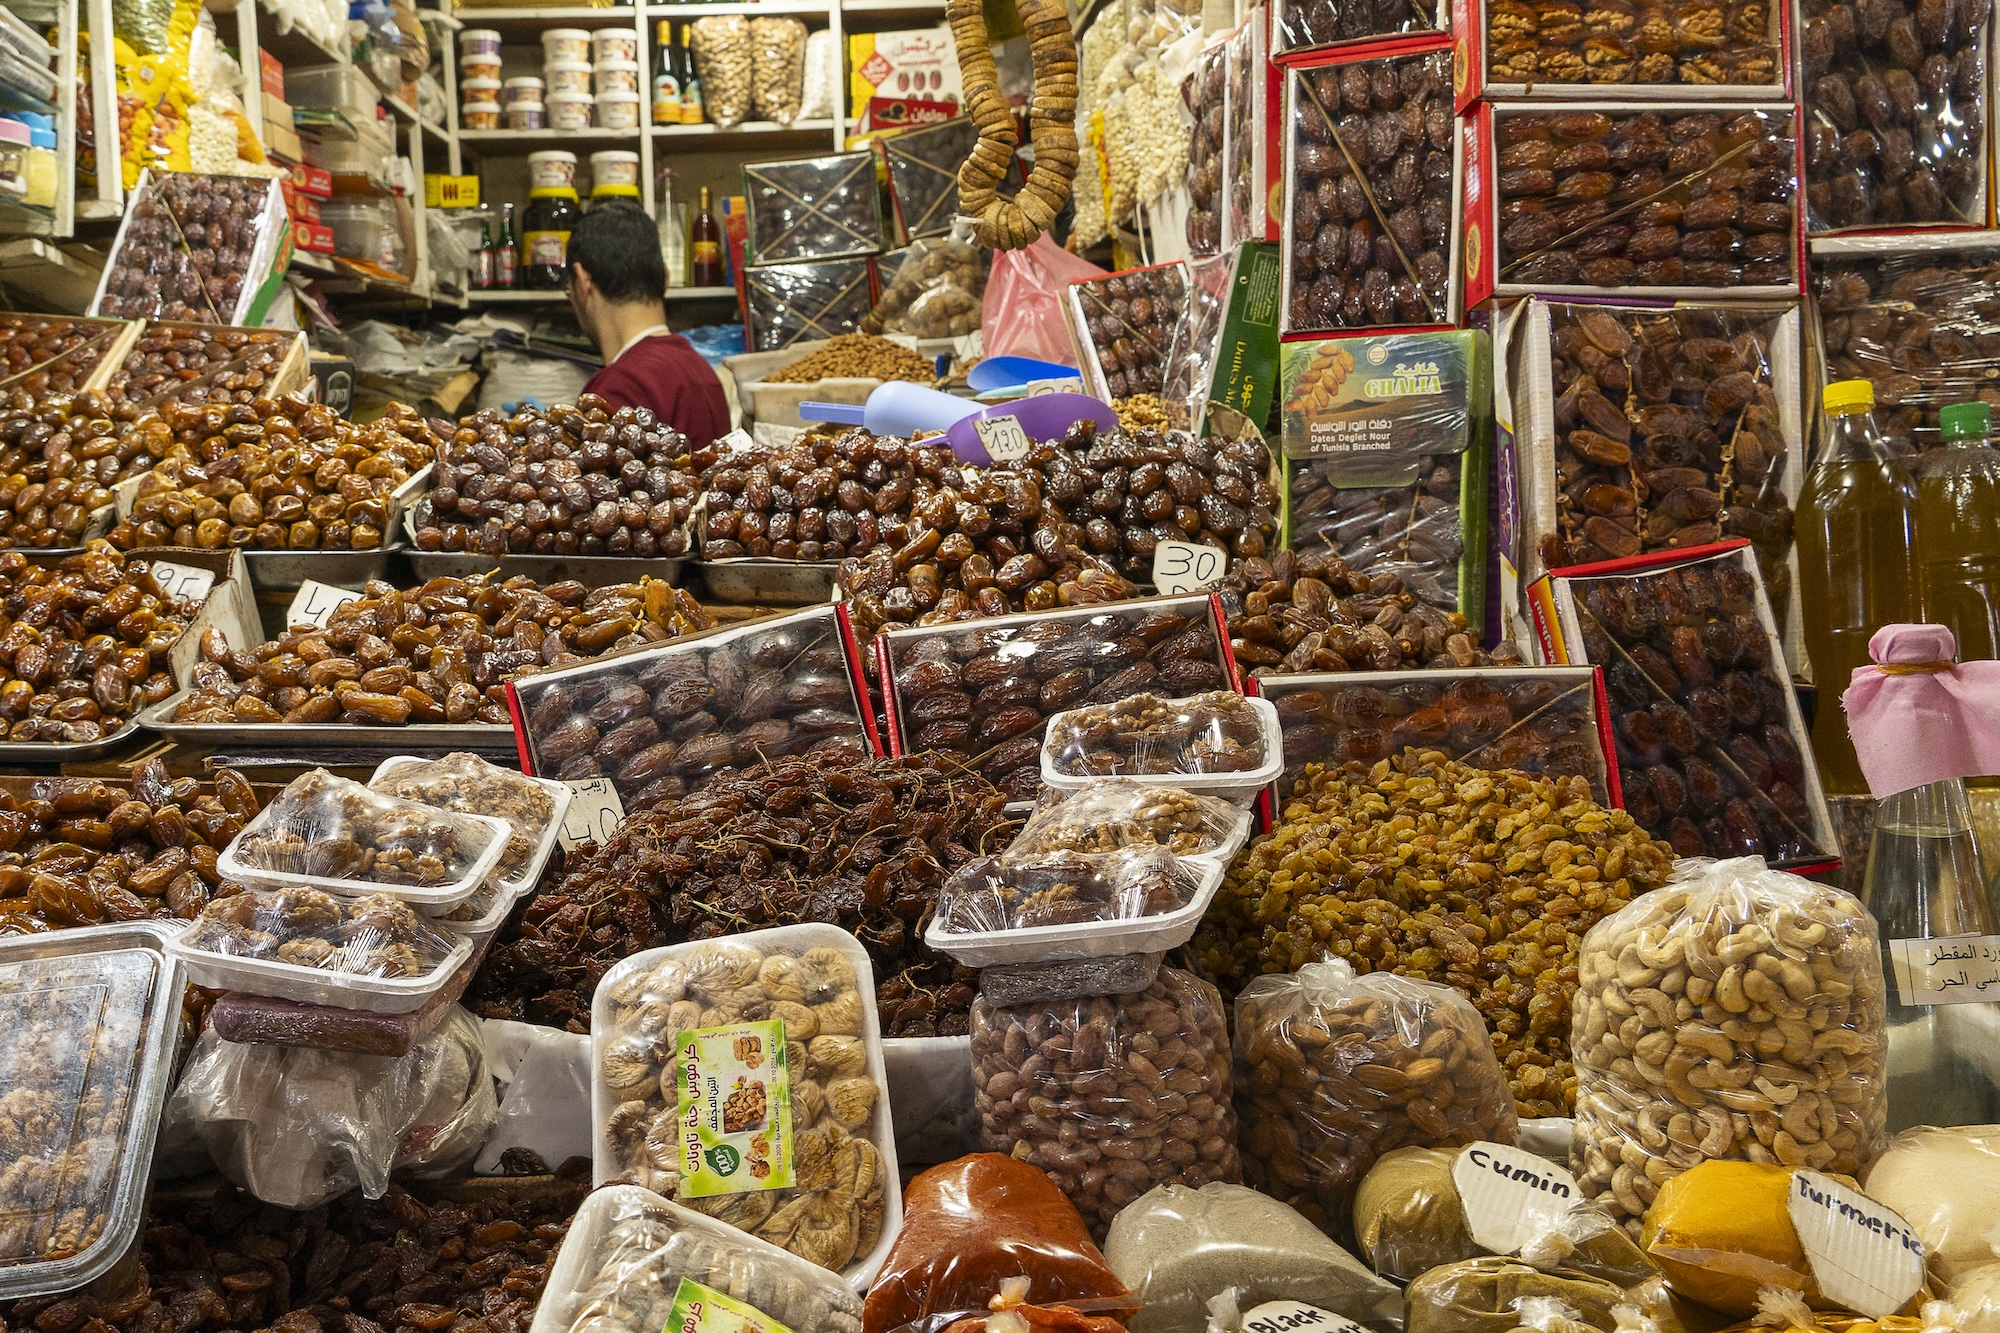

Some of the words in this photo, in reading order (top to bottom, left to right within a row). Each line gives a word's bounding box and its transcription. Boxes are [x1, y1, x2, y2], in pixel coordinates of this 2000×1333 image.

[1393, 361, 1439, 376] غالية
[1365, 376, 1442, 397] GHALIA
[1310, 443, 1320, 452] of
[1322, 443, 1350, 452] Tunisia
[1352, 441, 1391, 451] Branched
[1311, 434, 1336, 443] Dates
[1338, 433, 1367, 444] Deglet
[1369, 432, 1391, 441] Nour
[1160, 546, 1216, 581] 30
[156, 568, 201, 600] 95
[1533, 599, 1557, 664] Majhoul
[1927, 944, 1977, 966] المقطر
[1934, 970, 1969, 992] الحر
[684, 1043, 701, 1099] كرموس
[707, 1077, 720, 1096] التين
[685, 1104, 702, 1128] جنة
[686, 1132, 703, 1172] تاونات
[1469, 1150, 1570, 1198] Cumin
[1796, 1174, 1923, 1257] Turmeric
